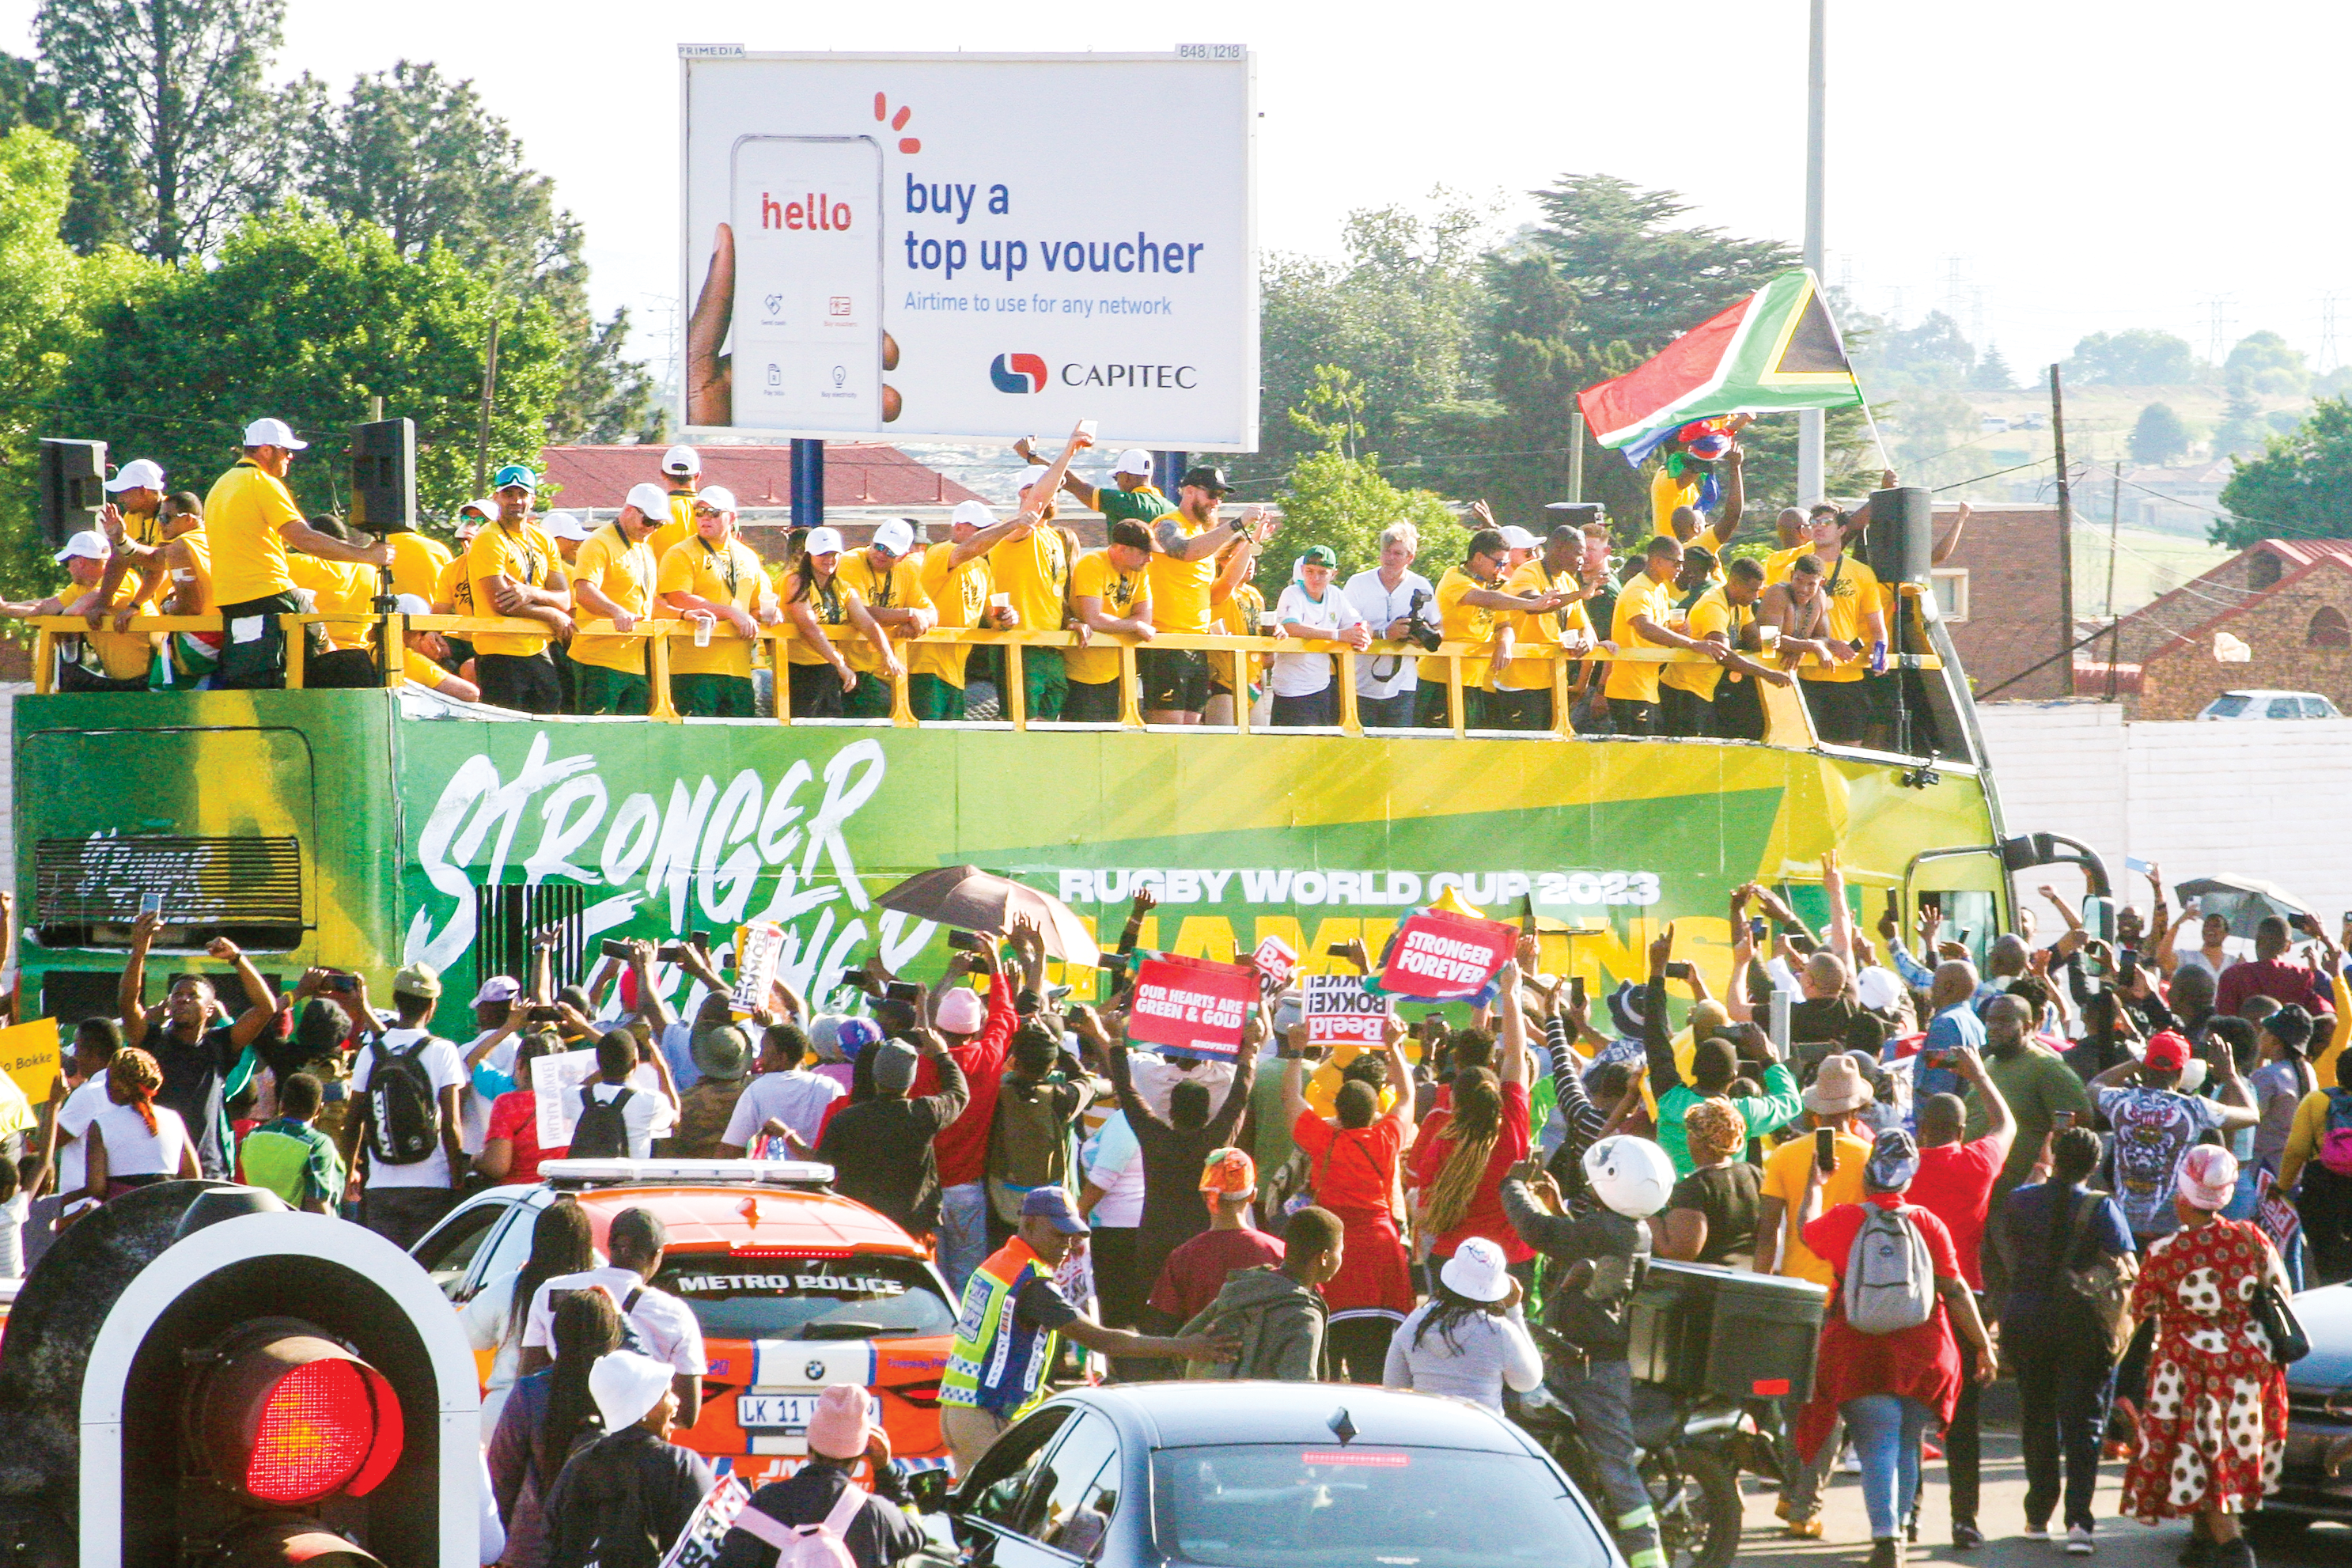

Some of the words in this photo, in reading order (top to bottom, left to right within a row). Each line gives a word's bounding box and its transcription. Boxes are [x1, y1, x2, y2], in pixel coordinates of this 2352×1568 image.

[678, 47, 743, 55] PRIMEDIA
[762, 192, 851, 230] hello
[906, 172, 975, 223] buy
[988, 183, 1009, 214] a
[905, 231, 966, 280] top
[981, 239, 1027, 280] up
[1041, 232, 1203, 273] voucher
[905, 292, 970, 312] Airtime
[974, 294, 990, 312] to
[996, 297, 1026, 313] use
[1032, 294, 1057, 313] for
[1061, 297, 1093, 318] any
[1100, 296, 1172, 316] network
[1062, 363, 1197, 389] CAPITEC
[404, 730, 886, 975] STRONGER
[1059, 869, 1234, 903] RUGBY
[1240, 870, 1421, 906] WORLD
[1428, 872, 1530, 906] CUP
[1537, 872, 1660, 906] 2023
[1404, 930, 1494, 967] STRONGER
[1397, 949, 1487, 983] FOREVER
[1135, 998, 1184, 1020] GREEN
[1185, 1006, 1199, 1022] &
[1202, 1009, 1241, 1029] GOLD
[1139, 983, 1167, 1001] OUR
[1168, 989, 1216, 1009] HEARTS
[1217, 998, 1243, 1014] ARE
[1309, 992, 1386, 1013] BOKKE!
[1309, 1016, 1384, 1040] Beeld
[678, 1274, 790, 1292] METRO
[794, 1274, 905, 1295] POLICE
[744, 1400, 767, 1422] LK
[778, 1399, 801, 1422] 11
